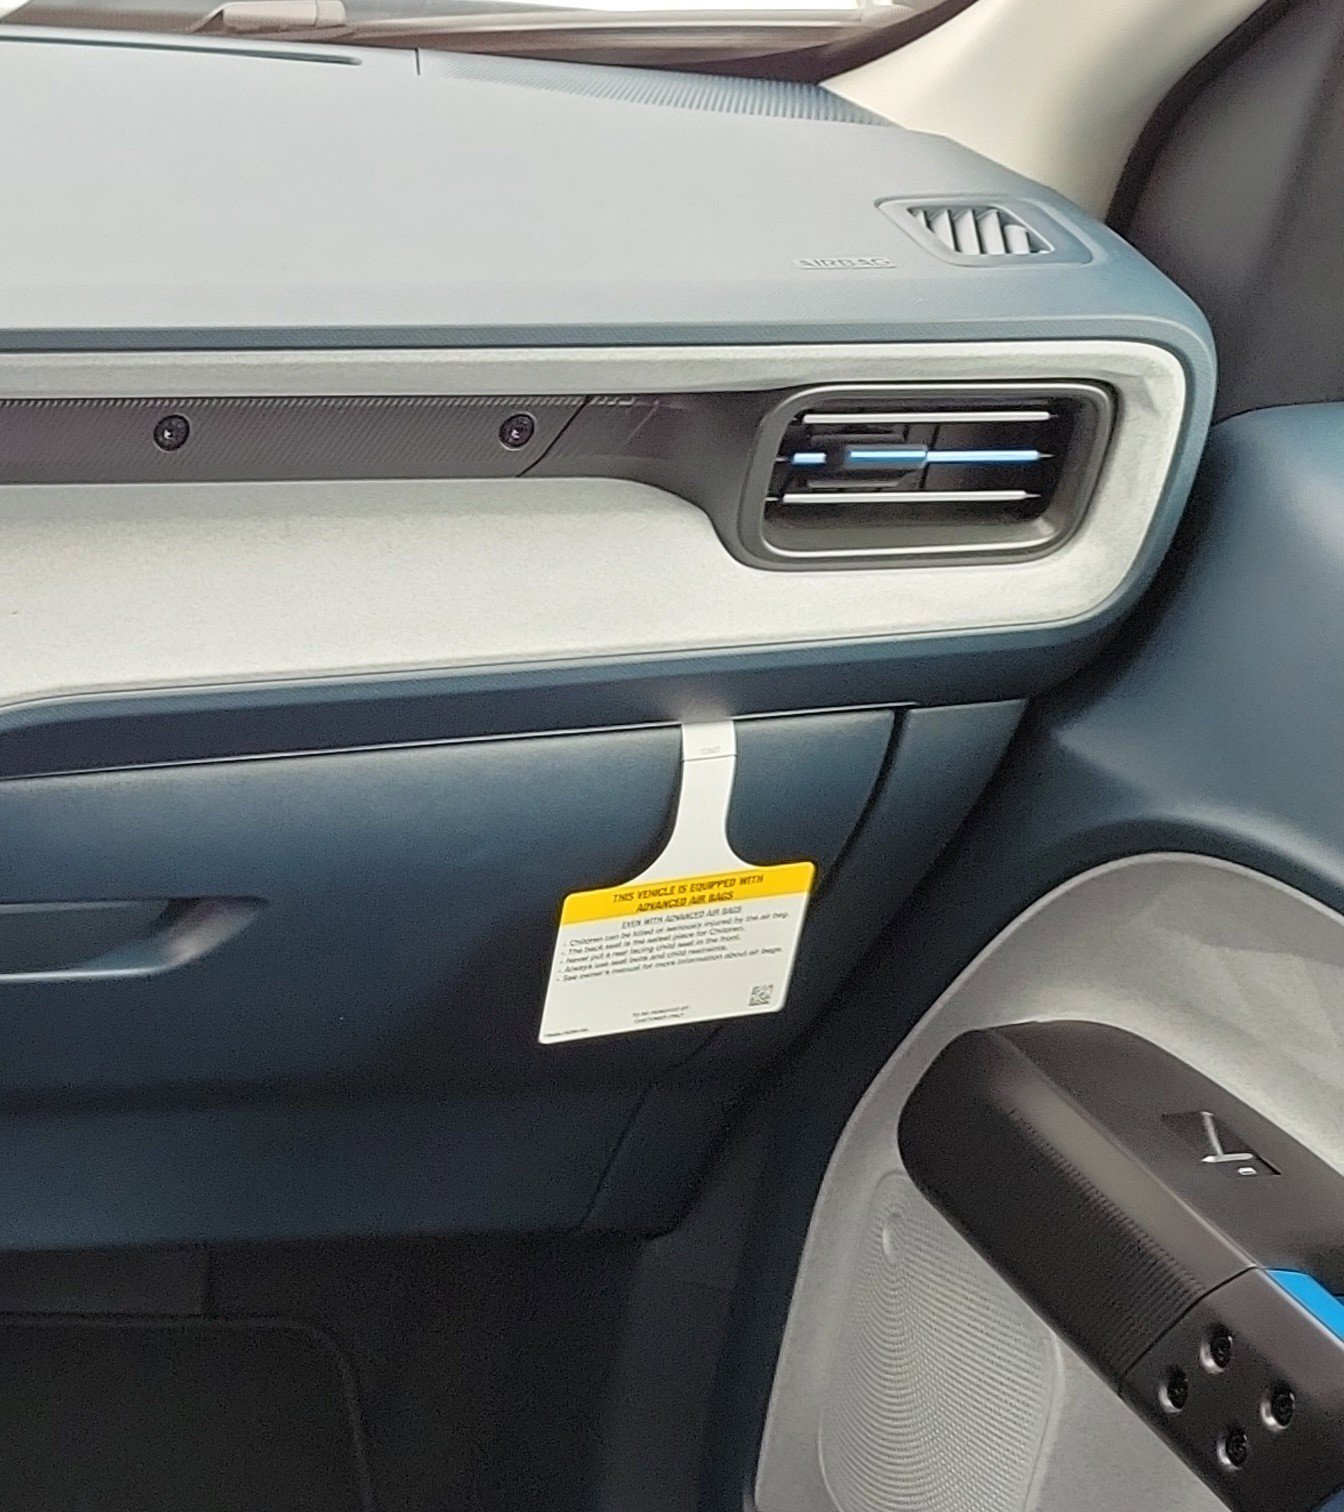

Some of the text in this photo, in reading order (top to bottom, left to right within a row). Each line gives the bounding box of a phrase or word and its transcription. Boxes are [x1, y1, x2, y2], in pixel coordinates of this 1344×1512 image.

[613, 874, 764, 904] THIS VEHICLE IS EQUIPPED WITH
[636, 891, 734, 913] ADVANCED AIR BAGS
